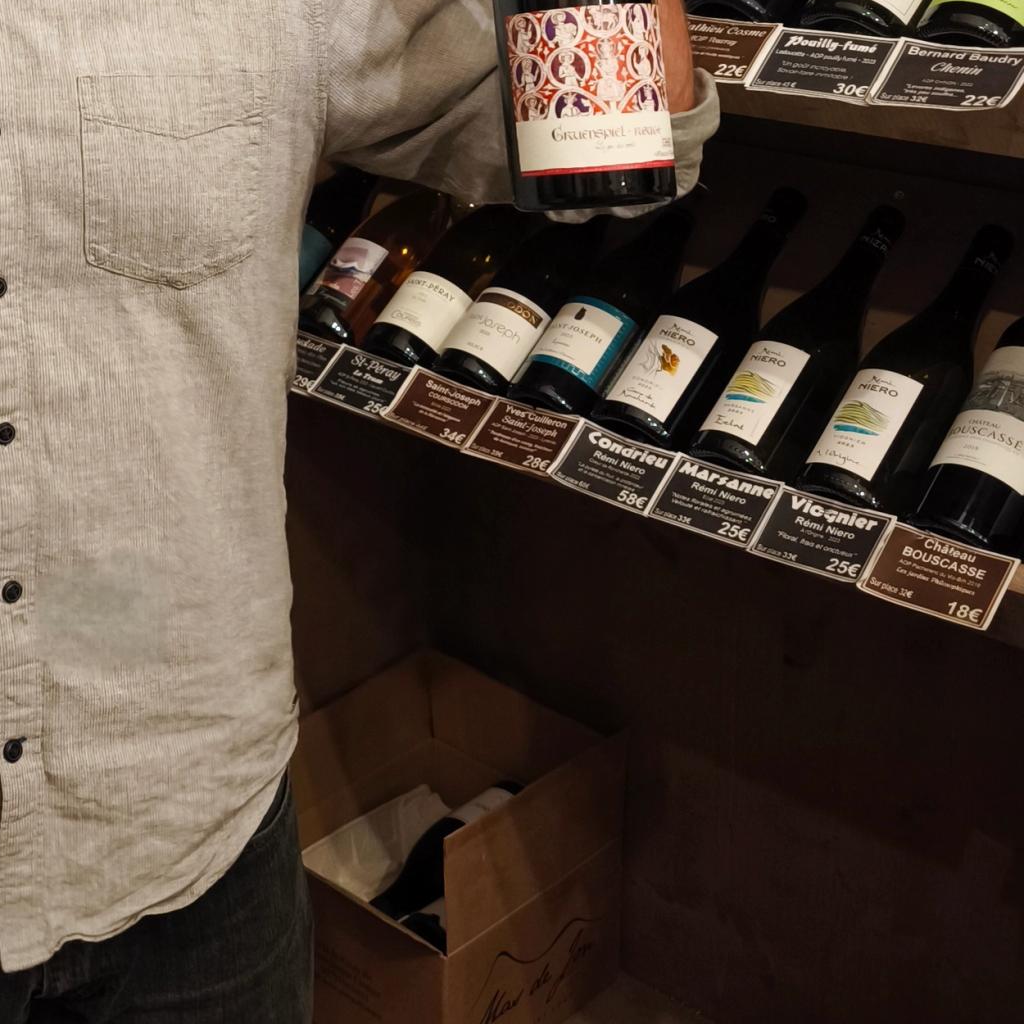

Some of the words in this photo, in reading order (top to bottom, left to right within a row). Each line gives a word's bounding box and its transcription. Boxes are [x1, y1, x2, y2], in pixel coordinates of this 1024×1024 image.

[784, 35, 878, 54] Pouilly-fumé
[907, 47, 967, 61] Bernard
[970, 53, 1024, 67] Baudry
[714, 63, 748, 78] 22€
[832, 82, 869, 98] 30€
[959, 94, 1002, 107] 22€
[426, 379, 482, 408] Saint-Joseph
[857, 381, 899, 398] NIERO
[501, 415, 558, 438] Saint-Joseph
[505, 404, 526, 416] Yves
[527, 411, 568, 430] Cuilleron
[439, 428, 467, 445] 34€
[587, 431, 669, 471] Condrieu
[593, 450, 619, 466] Rémi
[619, 460, 646, 476] Niero
[678, 461, 776, 500] Marsanne
[616, 489, 648, 510] 58€
[691, 481, 716, 496] Rémi
[717, 489, 747, 505] Niero
[791, 495, 878, 531] Viognier
[717, 521, 751, 542] 25€
[794, 515, 823, 533] Rémi
[825, 524, 856, 540] Niero
[923, 537, 977, 564] Château
[825, 557, 862, 578] 25€
[901, 546, 987, 581] BOUSCASSE
[869, 576, 883, 587] Sur
[882, 580, 899, 595] place
[946, 600, 984, 623] 18€
